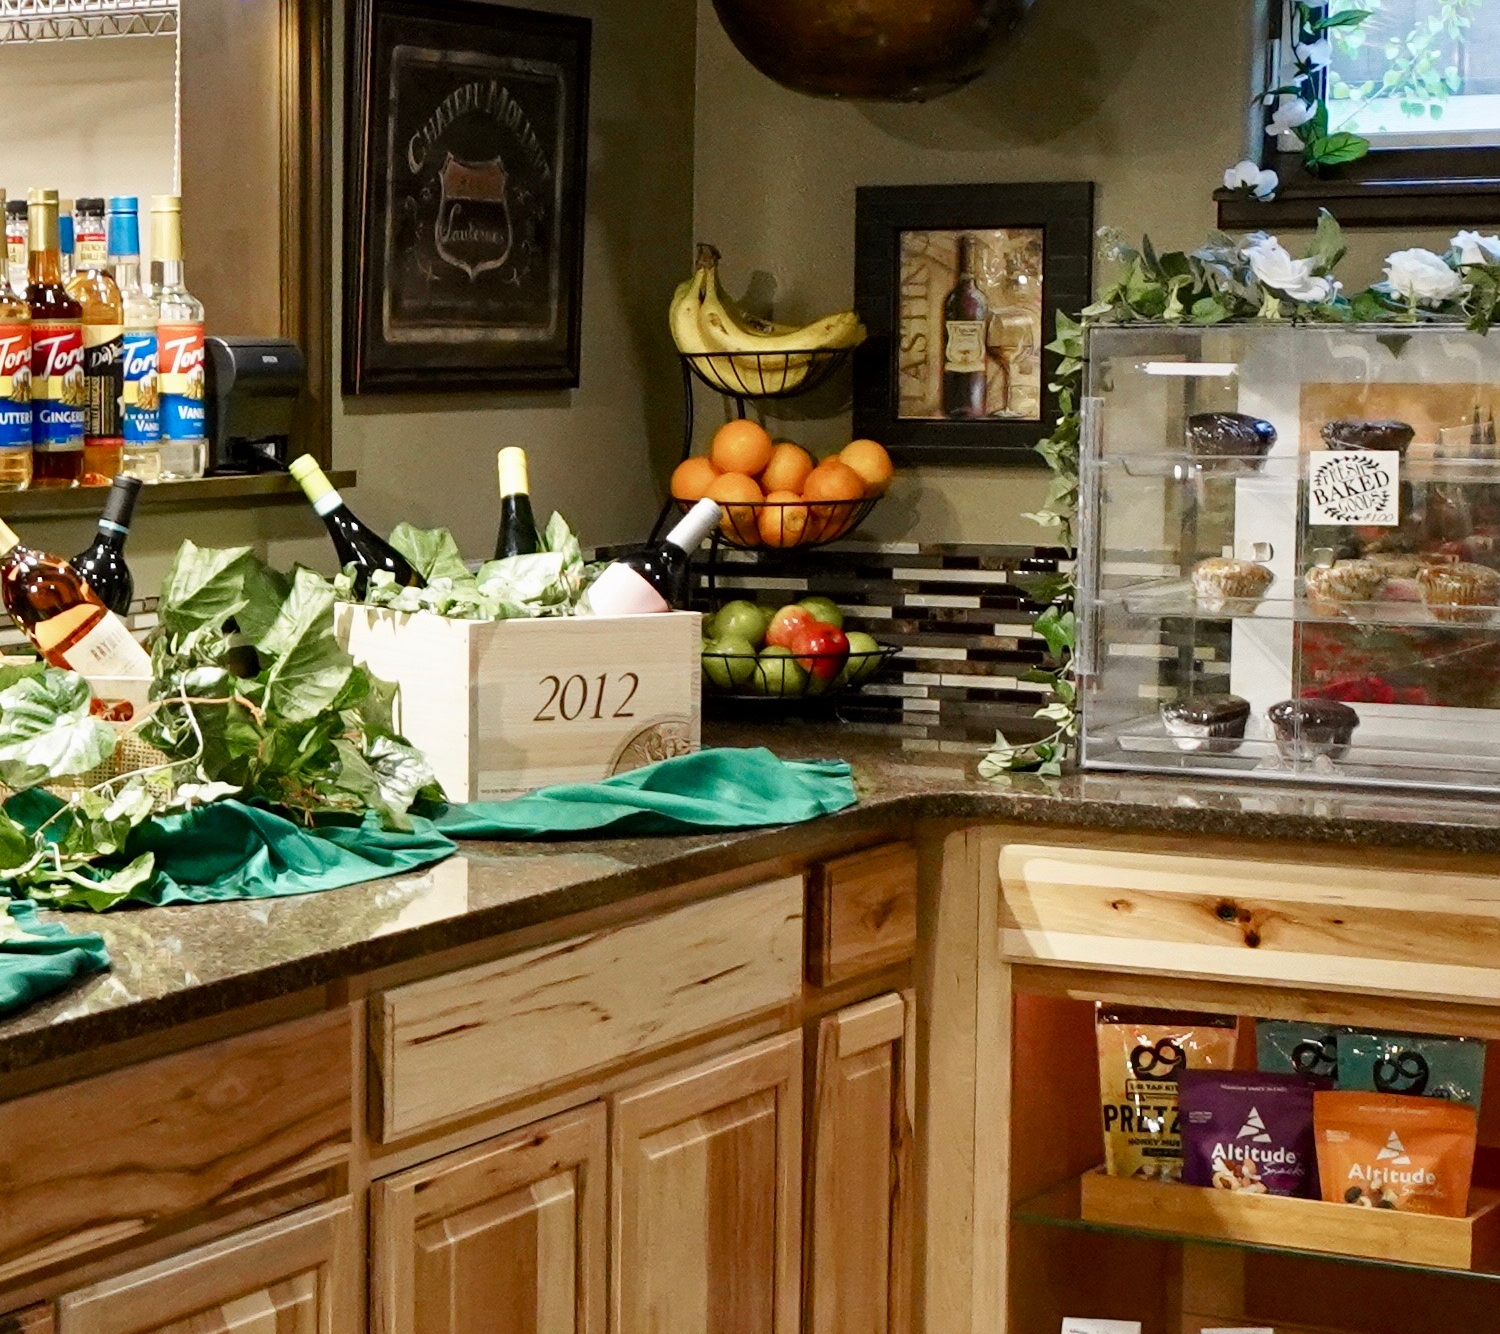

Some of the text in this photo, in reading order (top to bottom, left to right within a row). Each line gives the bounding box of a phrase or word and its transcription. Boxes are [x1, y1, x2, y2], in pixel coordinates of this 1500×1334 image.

[1313, 470, 1389, 507] BAKED
[533, 672, 640, 722] 2012
[1211, 1141, 1297, 1165] Altitude
[1348, 1163, 1437, 1186] Altitude
